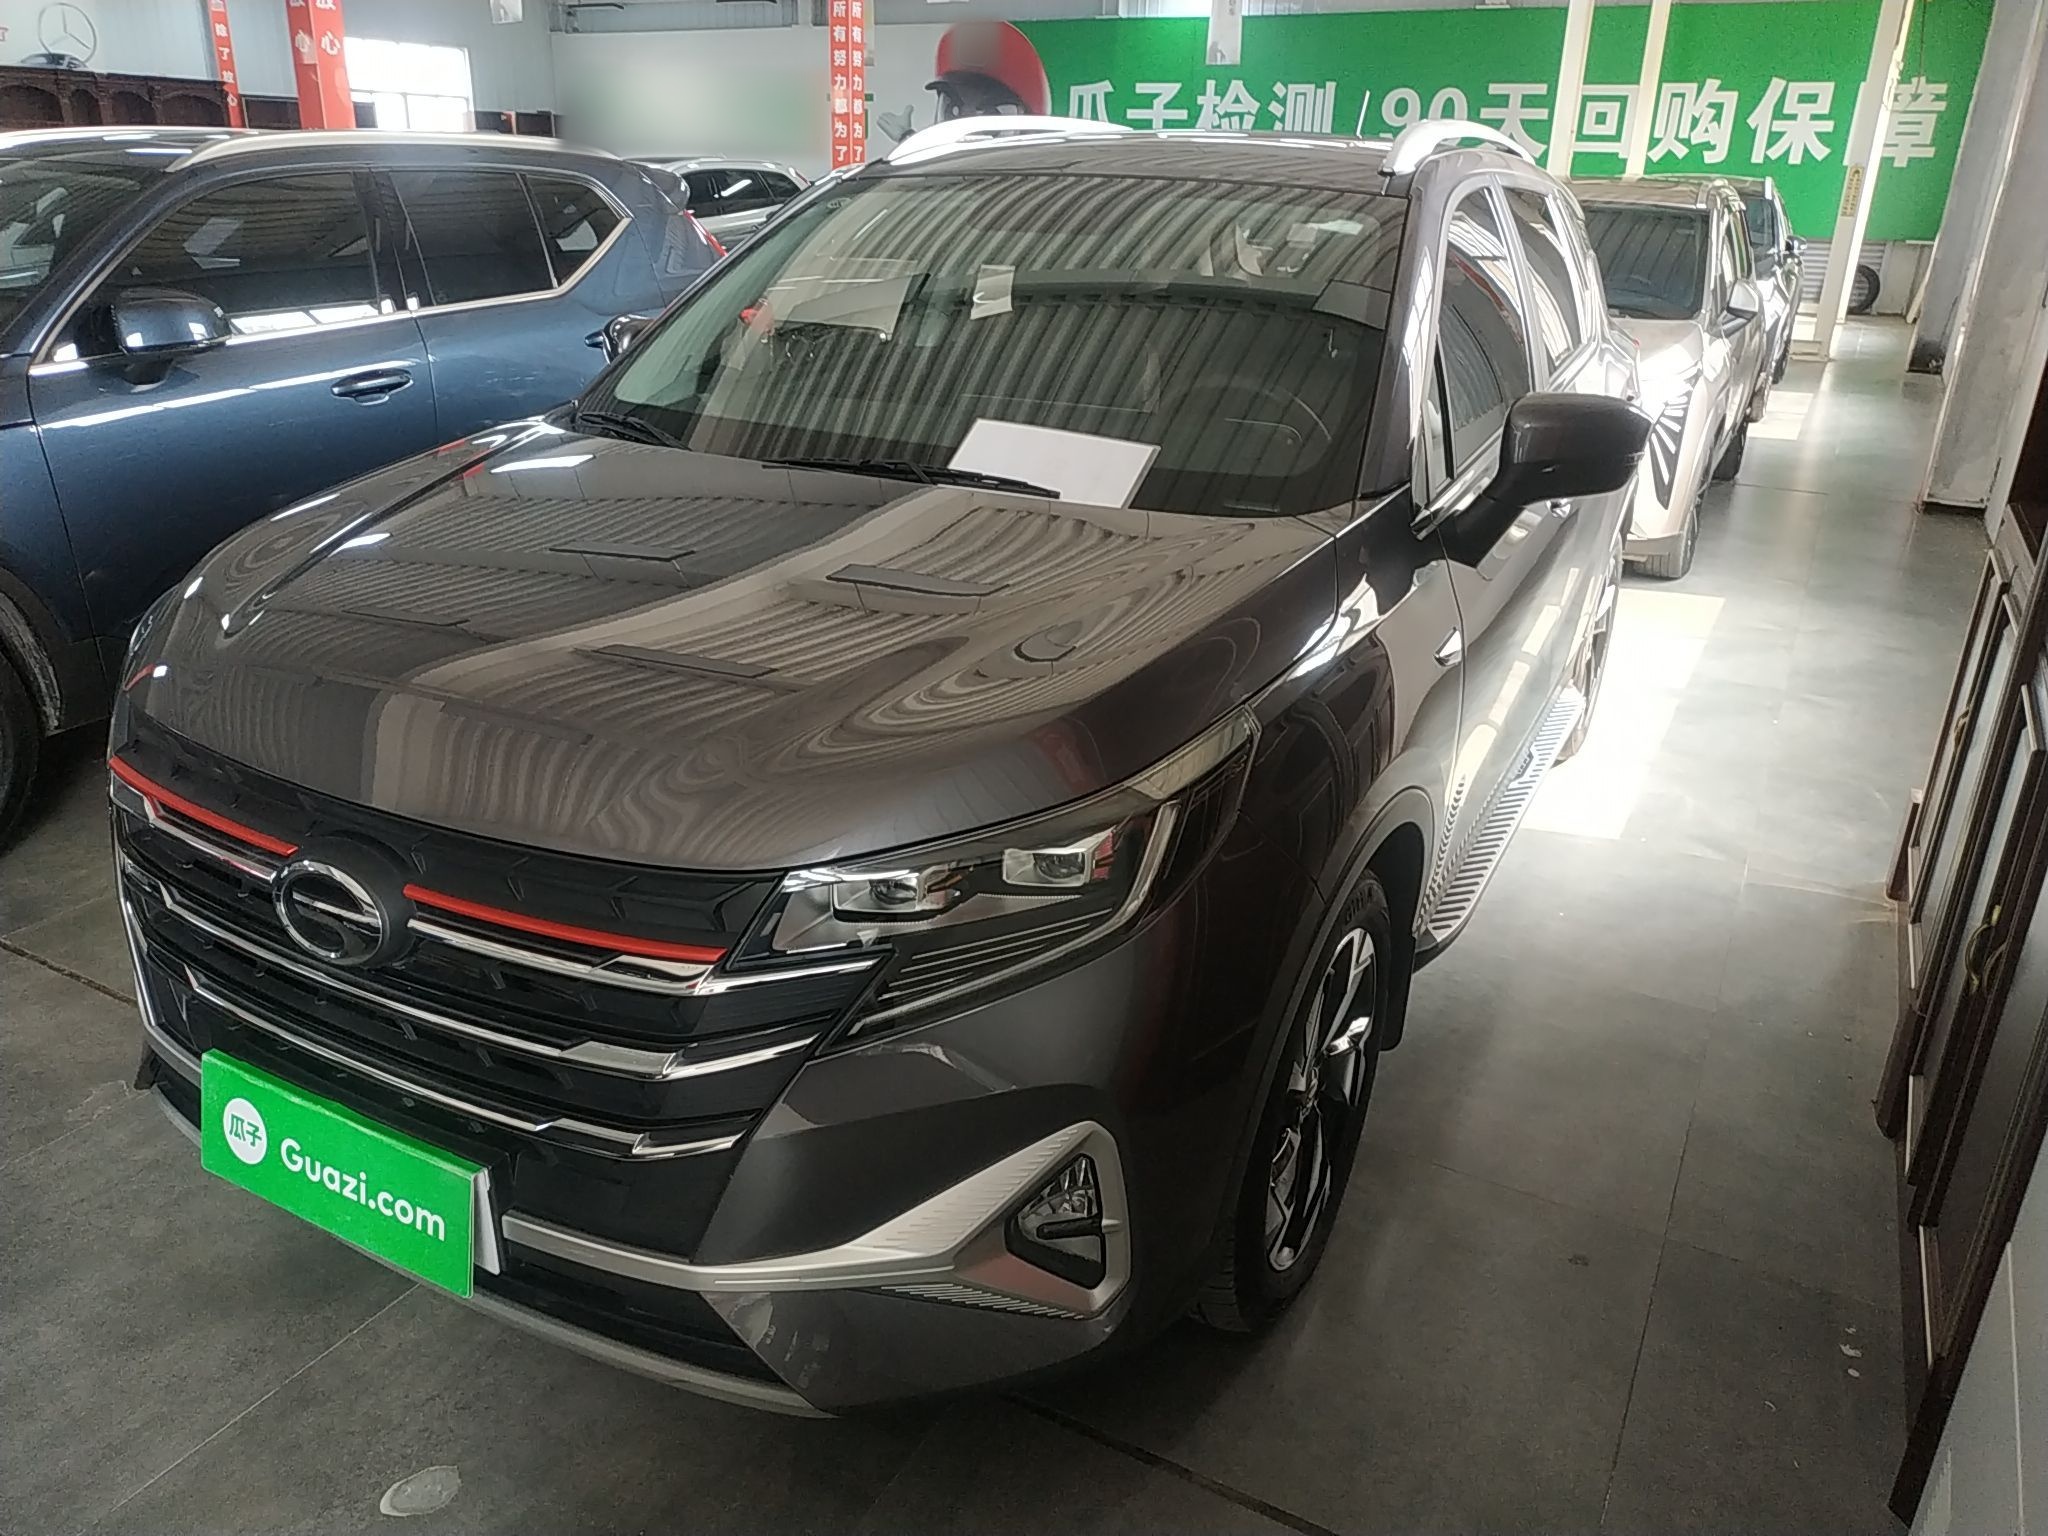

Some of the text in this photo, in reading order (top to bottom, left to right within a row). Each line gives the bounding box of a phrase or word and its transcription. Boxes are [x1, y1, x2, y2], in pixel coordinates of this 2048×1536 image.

[832, 1, 848, 162] 所有努力都为了
[851, 1, 863, 162] 所有努力都为了
[1069, 79, 1337, 133] 瓜子检测
[228, 1113, 263, 1147] 瓜子
[280, 1138, 445, 1241] Guazi.com
